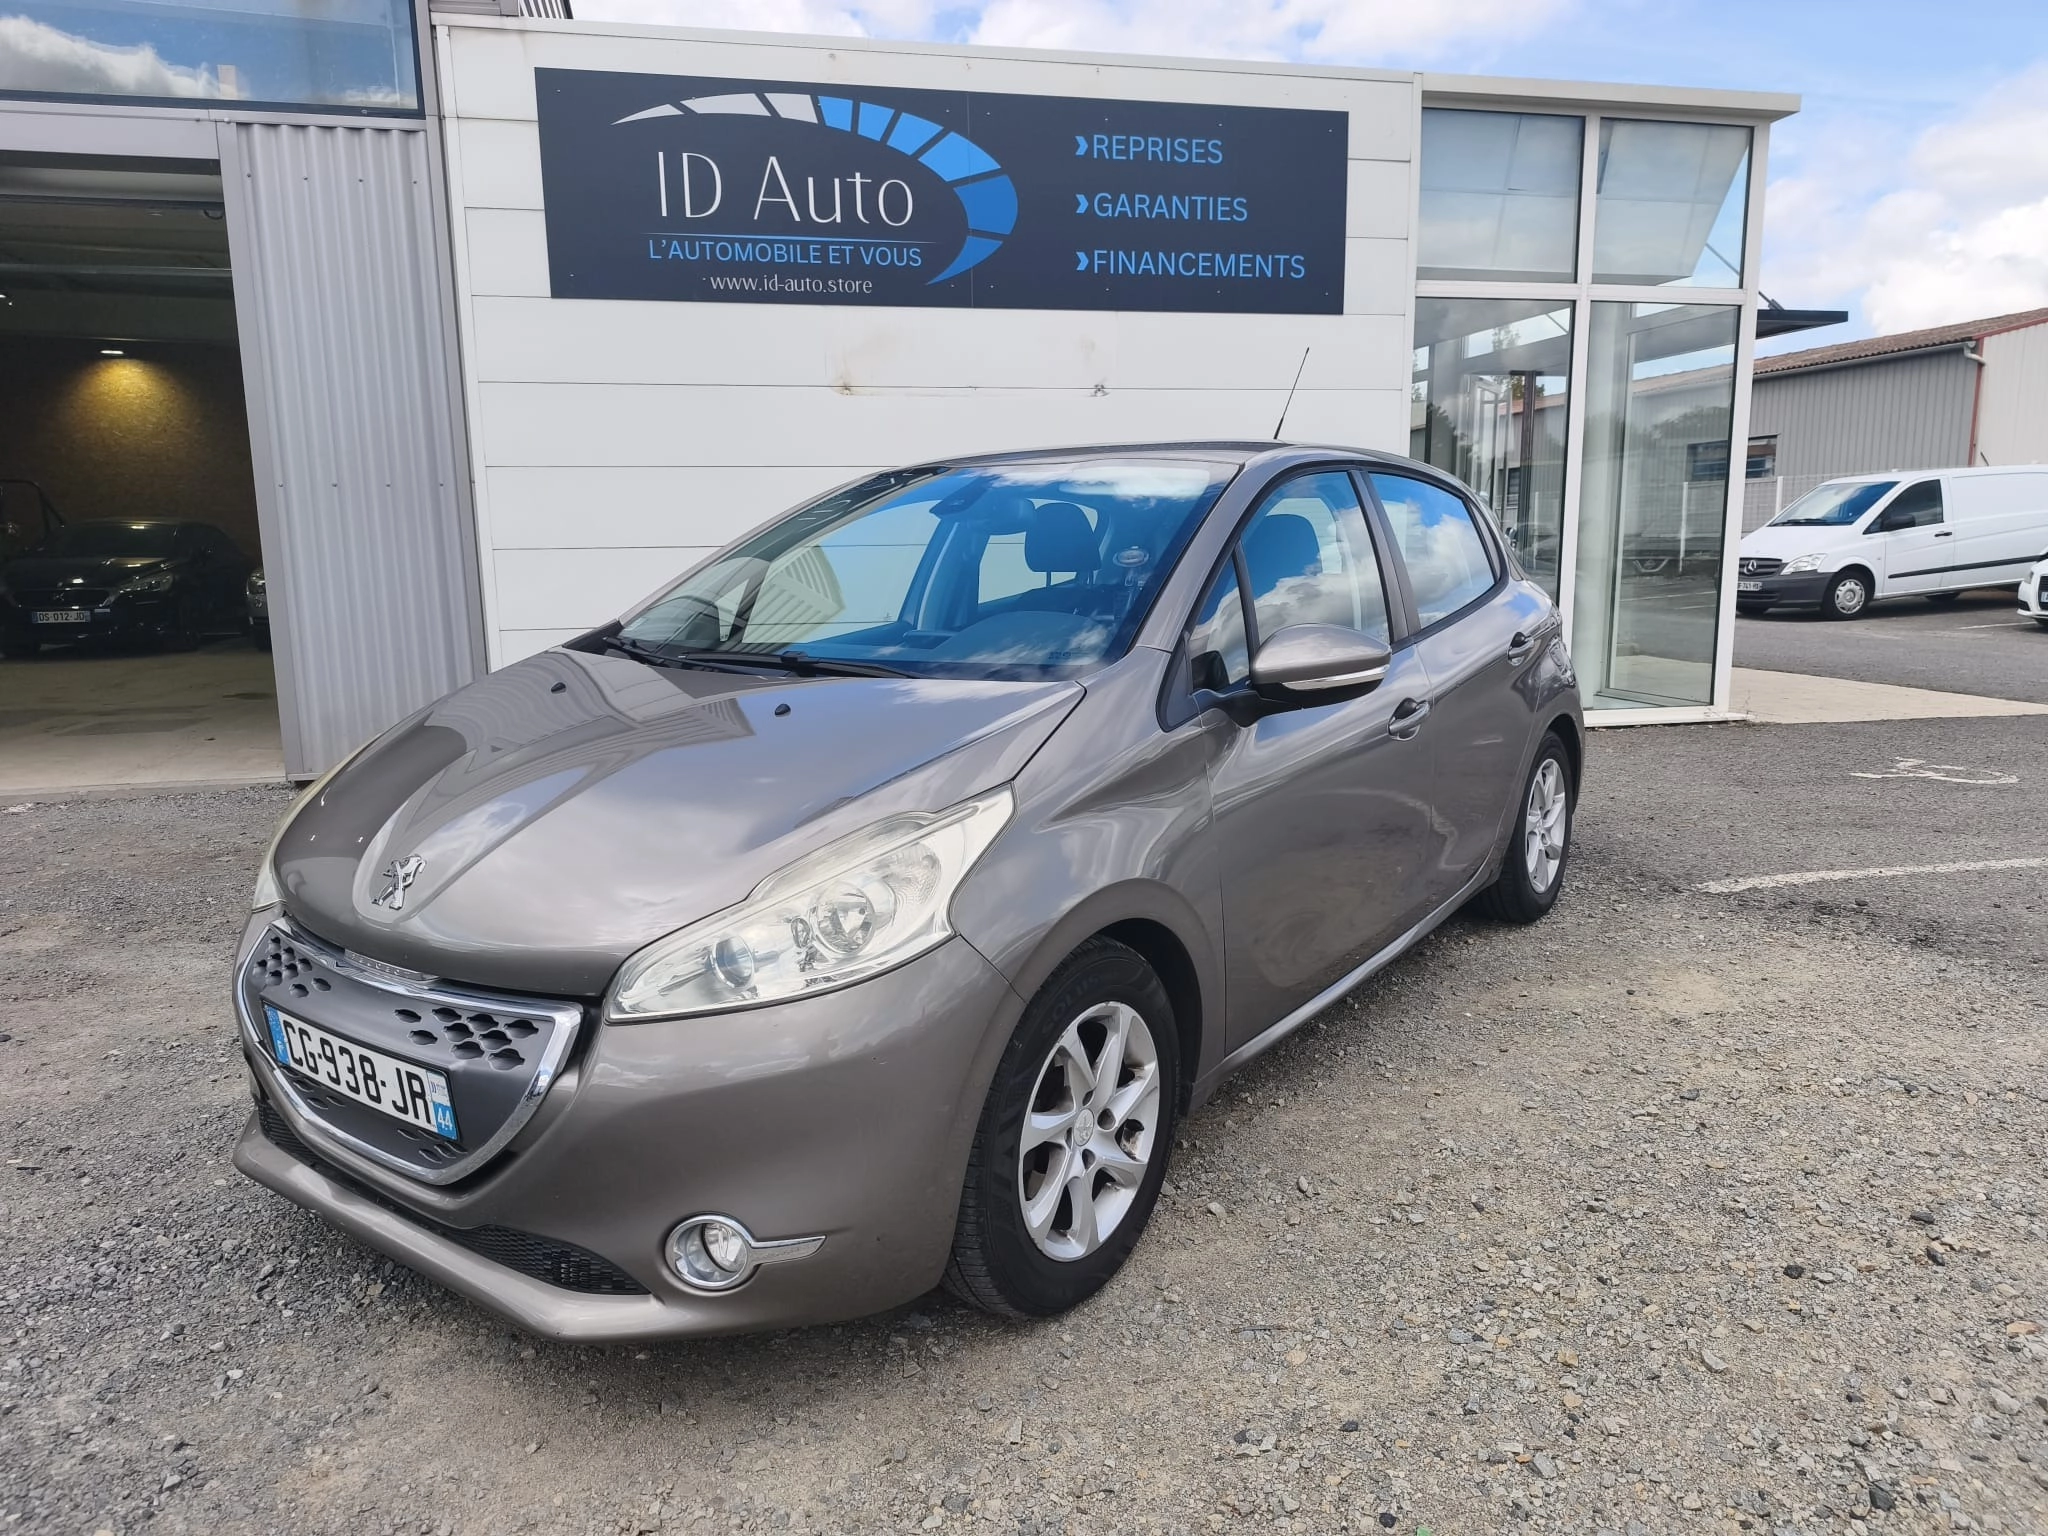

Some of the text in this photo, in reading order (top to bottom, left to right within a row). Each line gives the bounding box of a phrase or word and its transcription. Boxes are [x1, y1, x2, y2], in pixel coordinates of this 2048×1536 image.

[1092, 134, 1224, 164] REPRISES
[657, 150, 914, 227] ID Auto
[1093, 192, 1248, 222] GARANTIES
[649, 238, 922, 267] L’AUTOMOBILE ET VOUS
[1093, 249, 1306, 279] FINANCEMENTS
[710, 274, 873, 294] www.id-auto.store
[282, 1019, 431, 1125] CG-938-JR
[437, 1107, 453, 1131] 44
